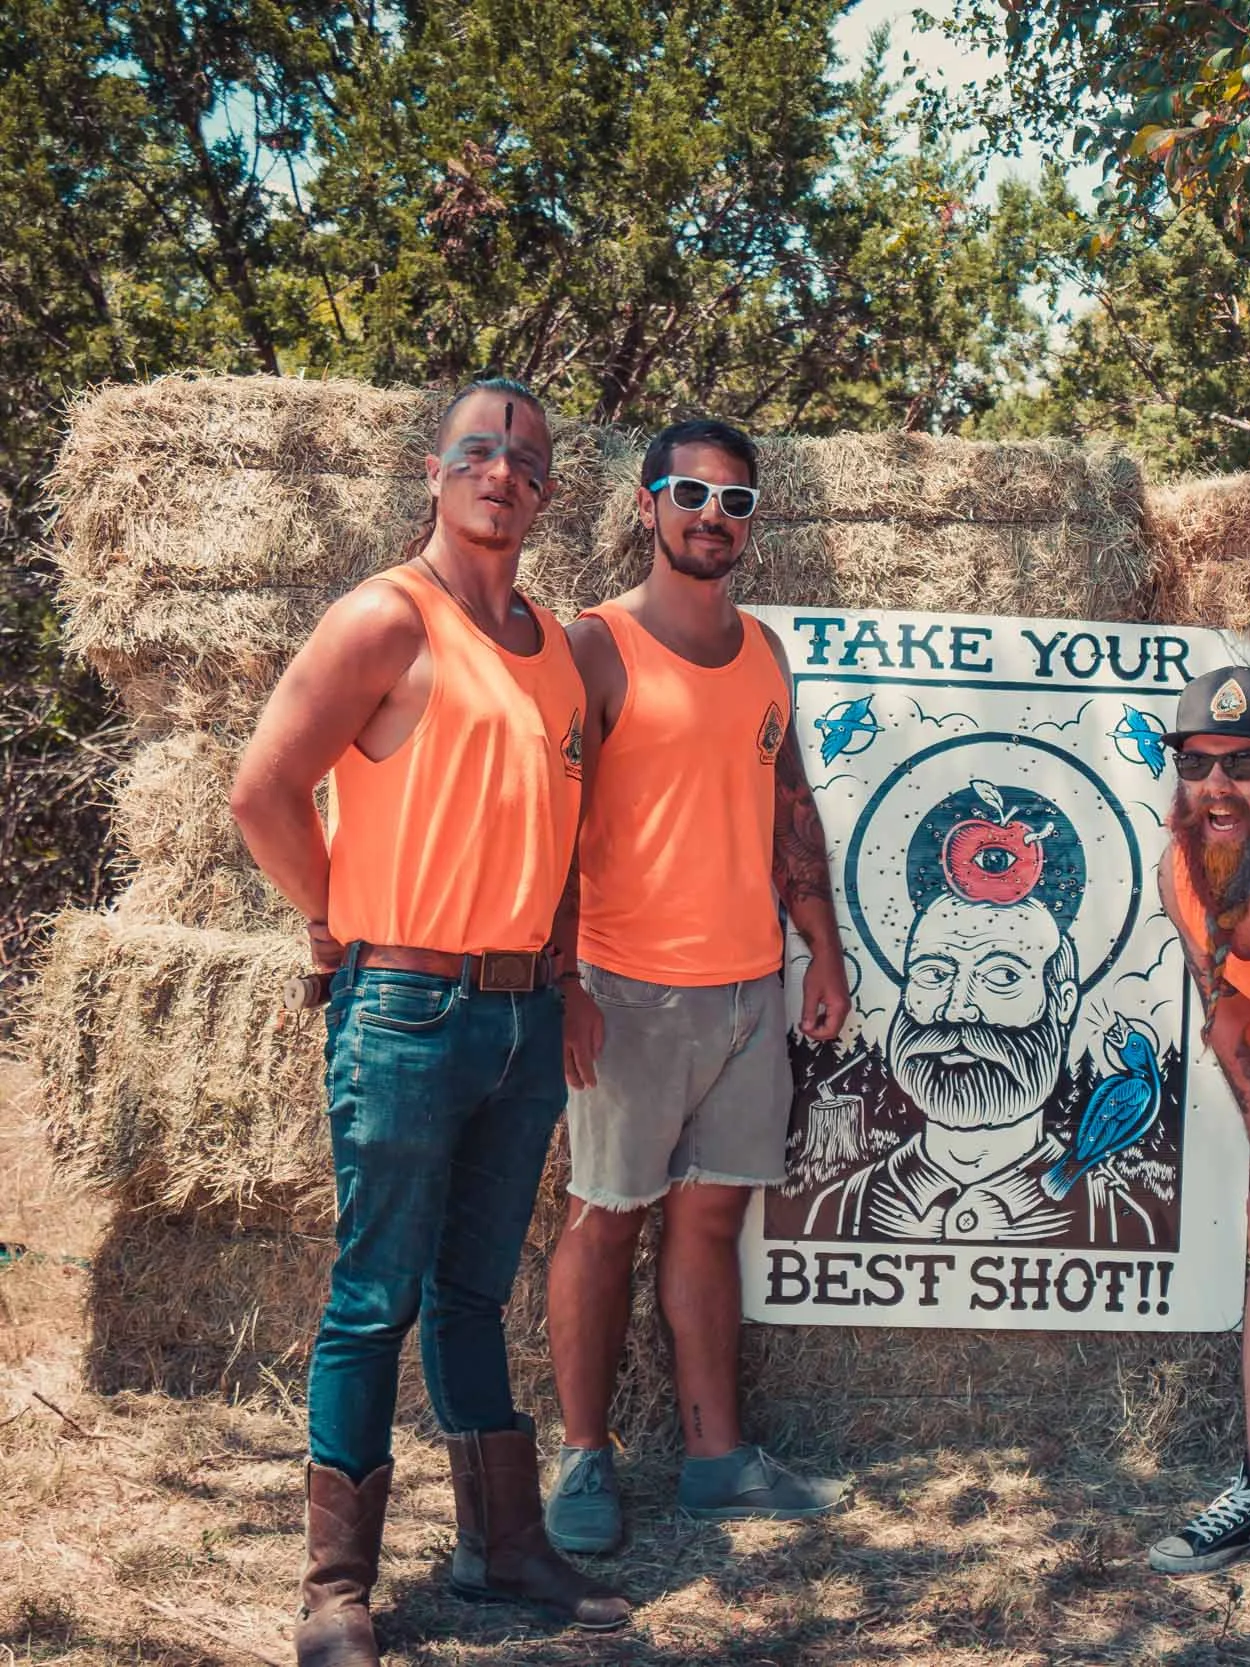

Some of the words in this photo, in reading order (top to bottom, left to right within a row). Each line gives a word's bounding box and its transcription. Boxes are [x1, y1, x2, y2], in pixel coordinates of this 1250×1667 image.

[793, 616, 994, 673] TAKE
[1020, 629, 1194, 683] YOUR
[764, 1248, 956, 1307] BEST
[969, 1255, 1175, 1316] SHOT!!
